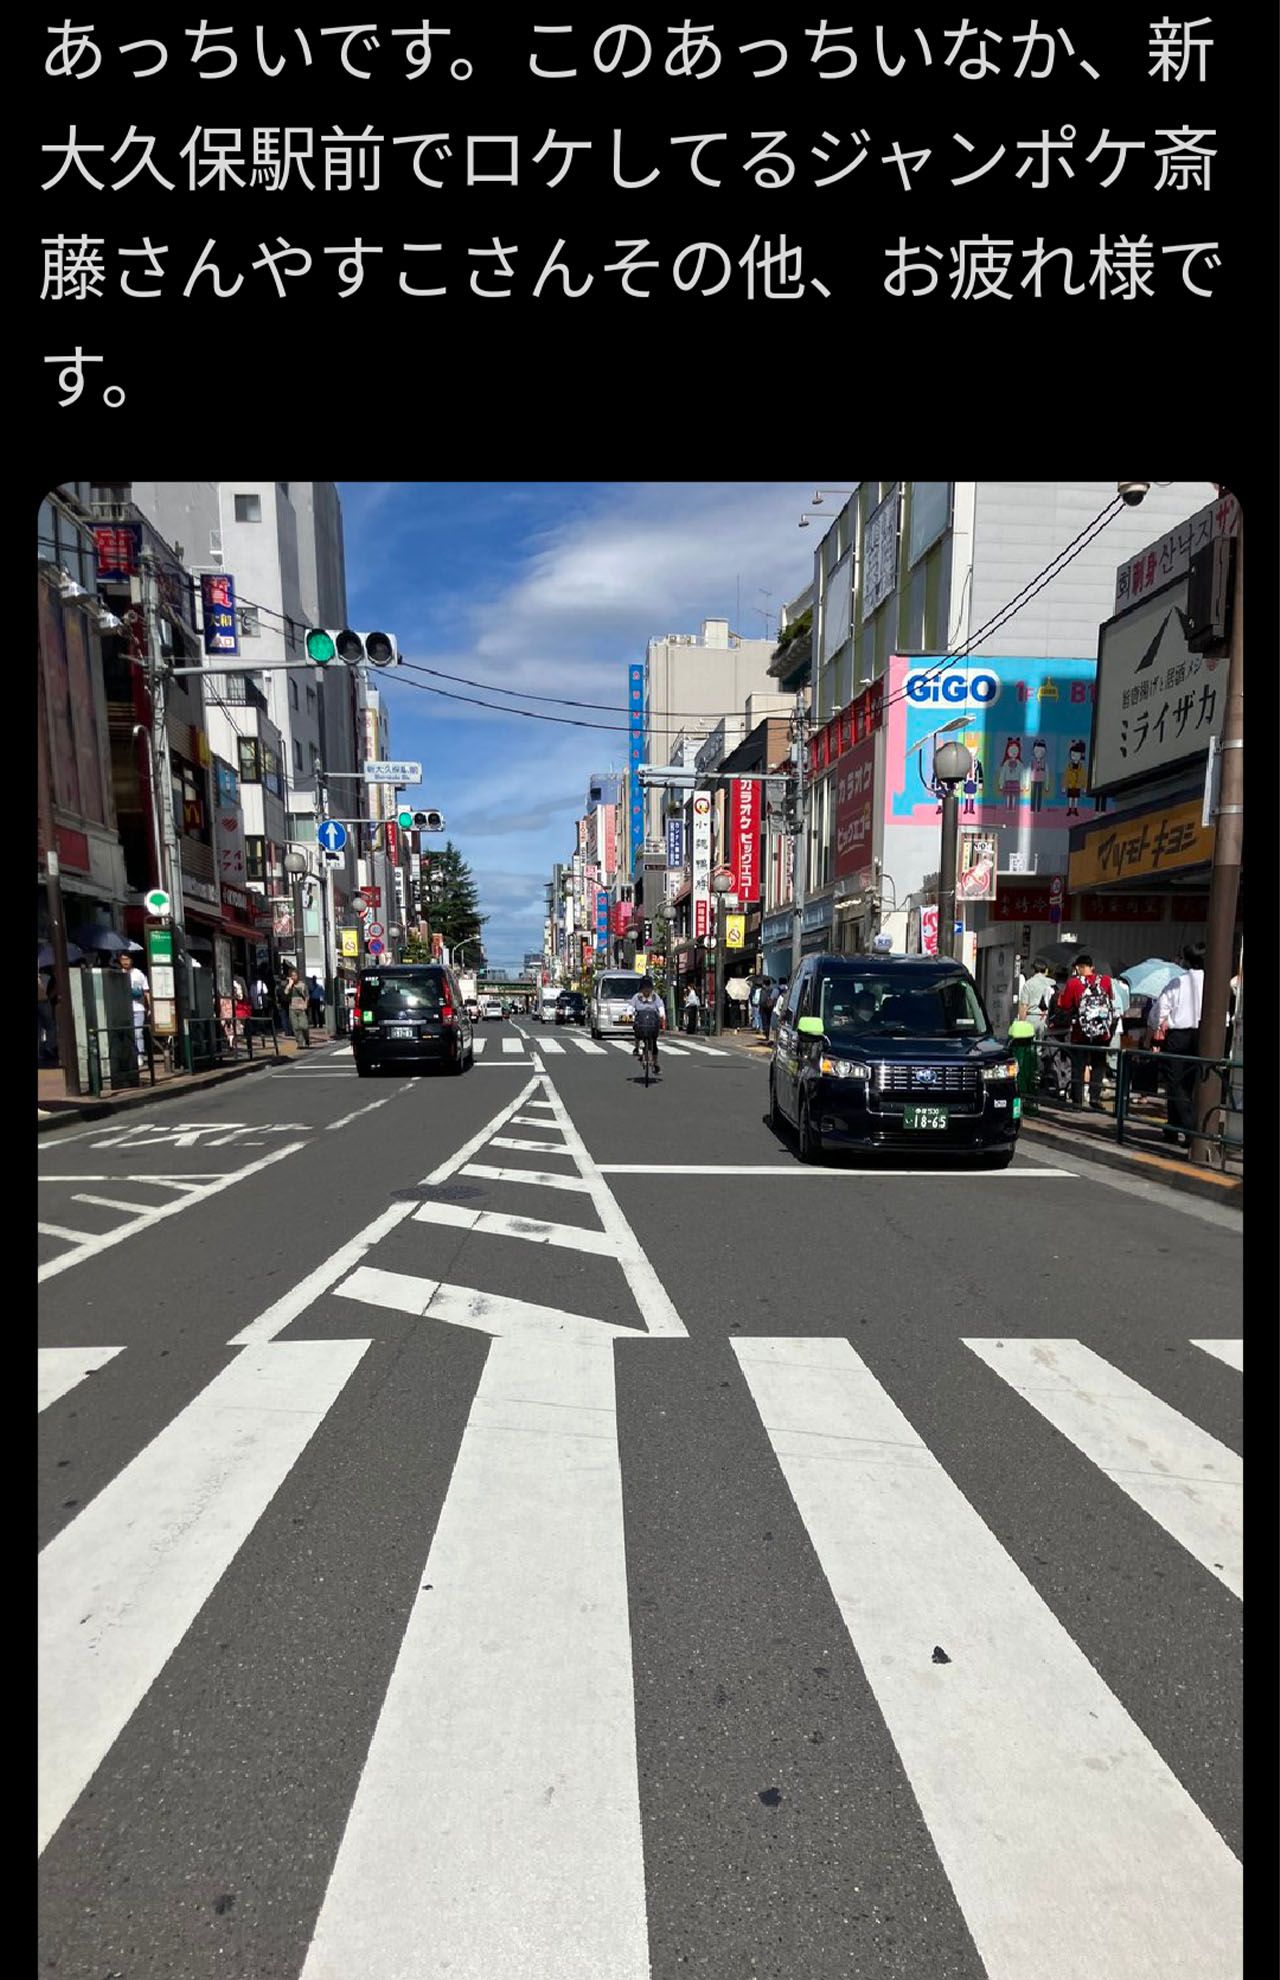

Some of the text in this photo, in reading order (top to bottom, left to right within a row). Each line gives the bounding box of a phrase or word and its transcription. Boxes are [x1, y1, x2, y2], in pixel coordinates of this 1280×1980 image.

[907, 674, 997, 703] GiGO
[1120, 684, 1216, 758] ミライザカ
[740, 780, 753, 898] カラオケ ビッグエコー
[1098, 819, 1197, 876] マツモトキヨシ
[914, 1114, 946, 1129] 18-65
